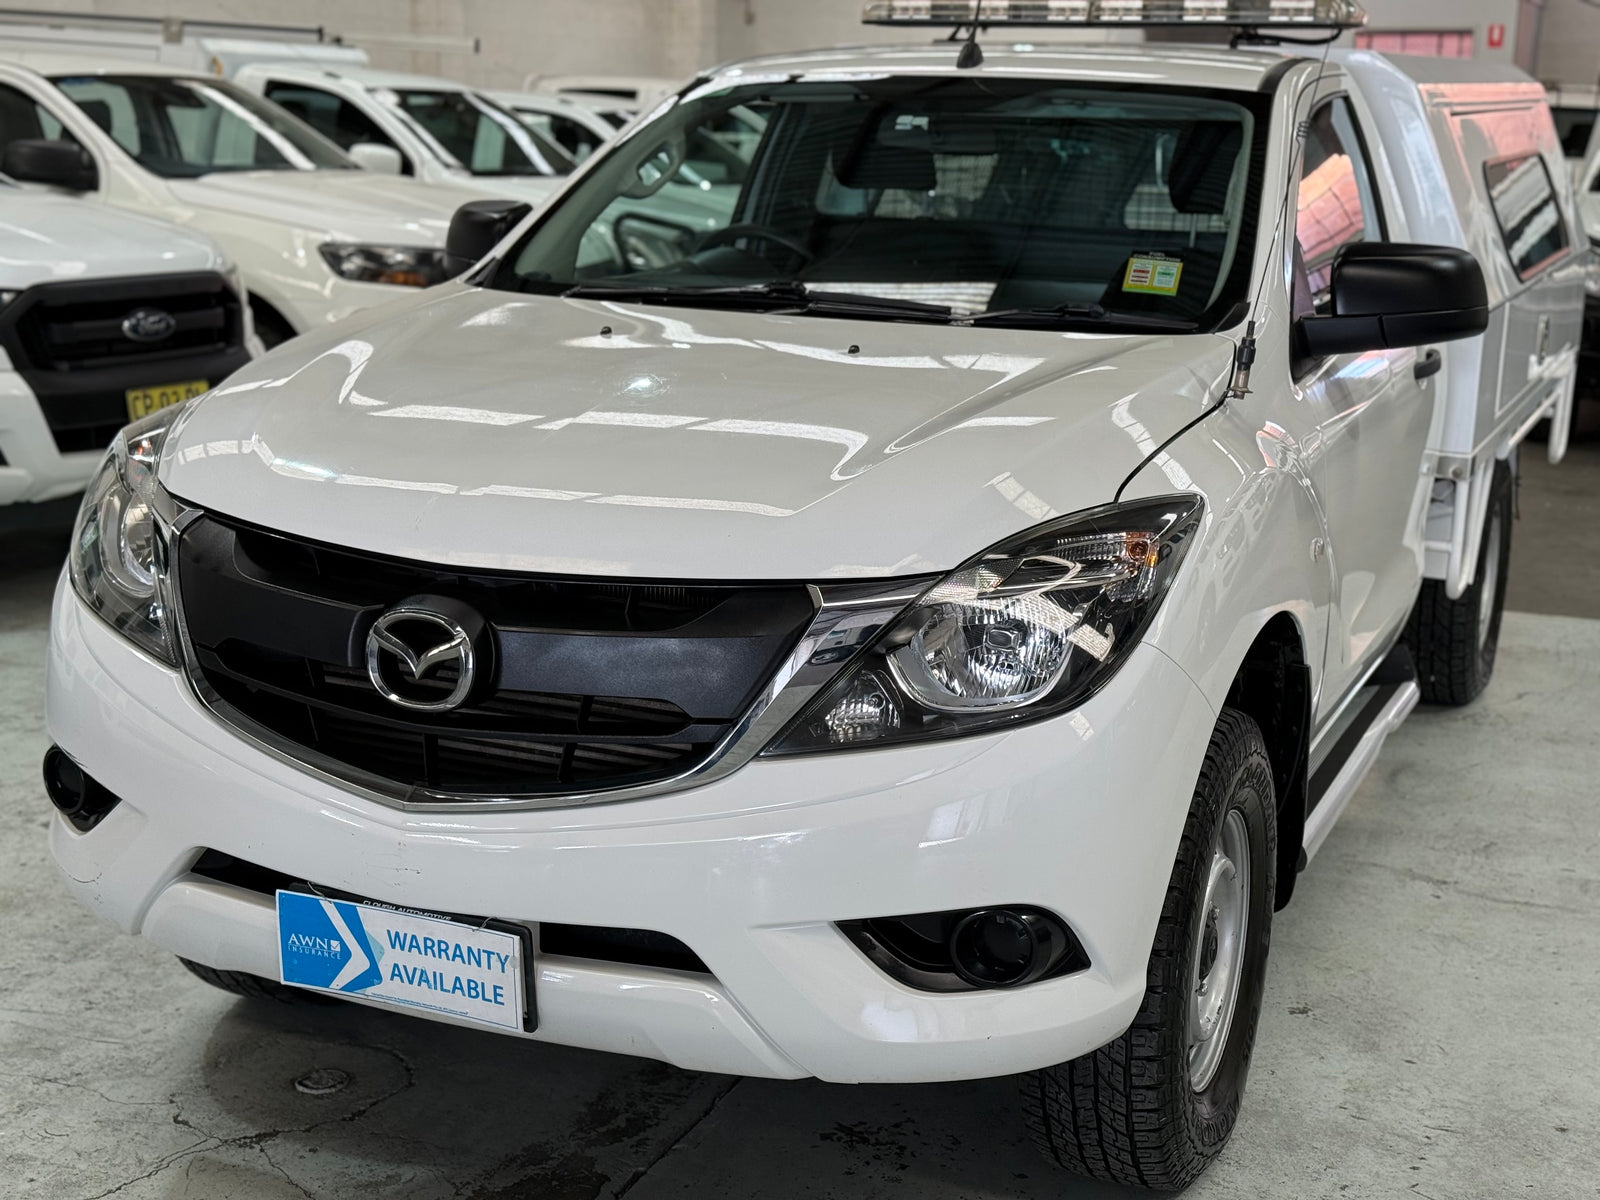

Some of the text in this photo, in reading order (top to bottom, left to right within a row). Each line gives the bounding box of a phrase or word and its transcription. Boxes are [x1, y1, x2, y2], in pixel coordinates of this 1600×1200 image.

[288, 932, 328, 950] AWN
[288, 944, 341, 960] INSURANCE
[386, 929, 511, 974] WARRANTY
[389, 962, 505, 1006] AVAILABLE
